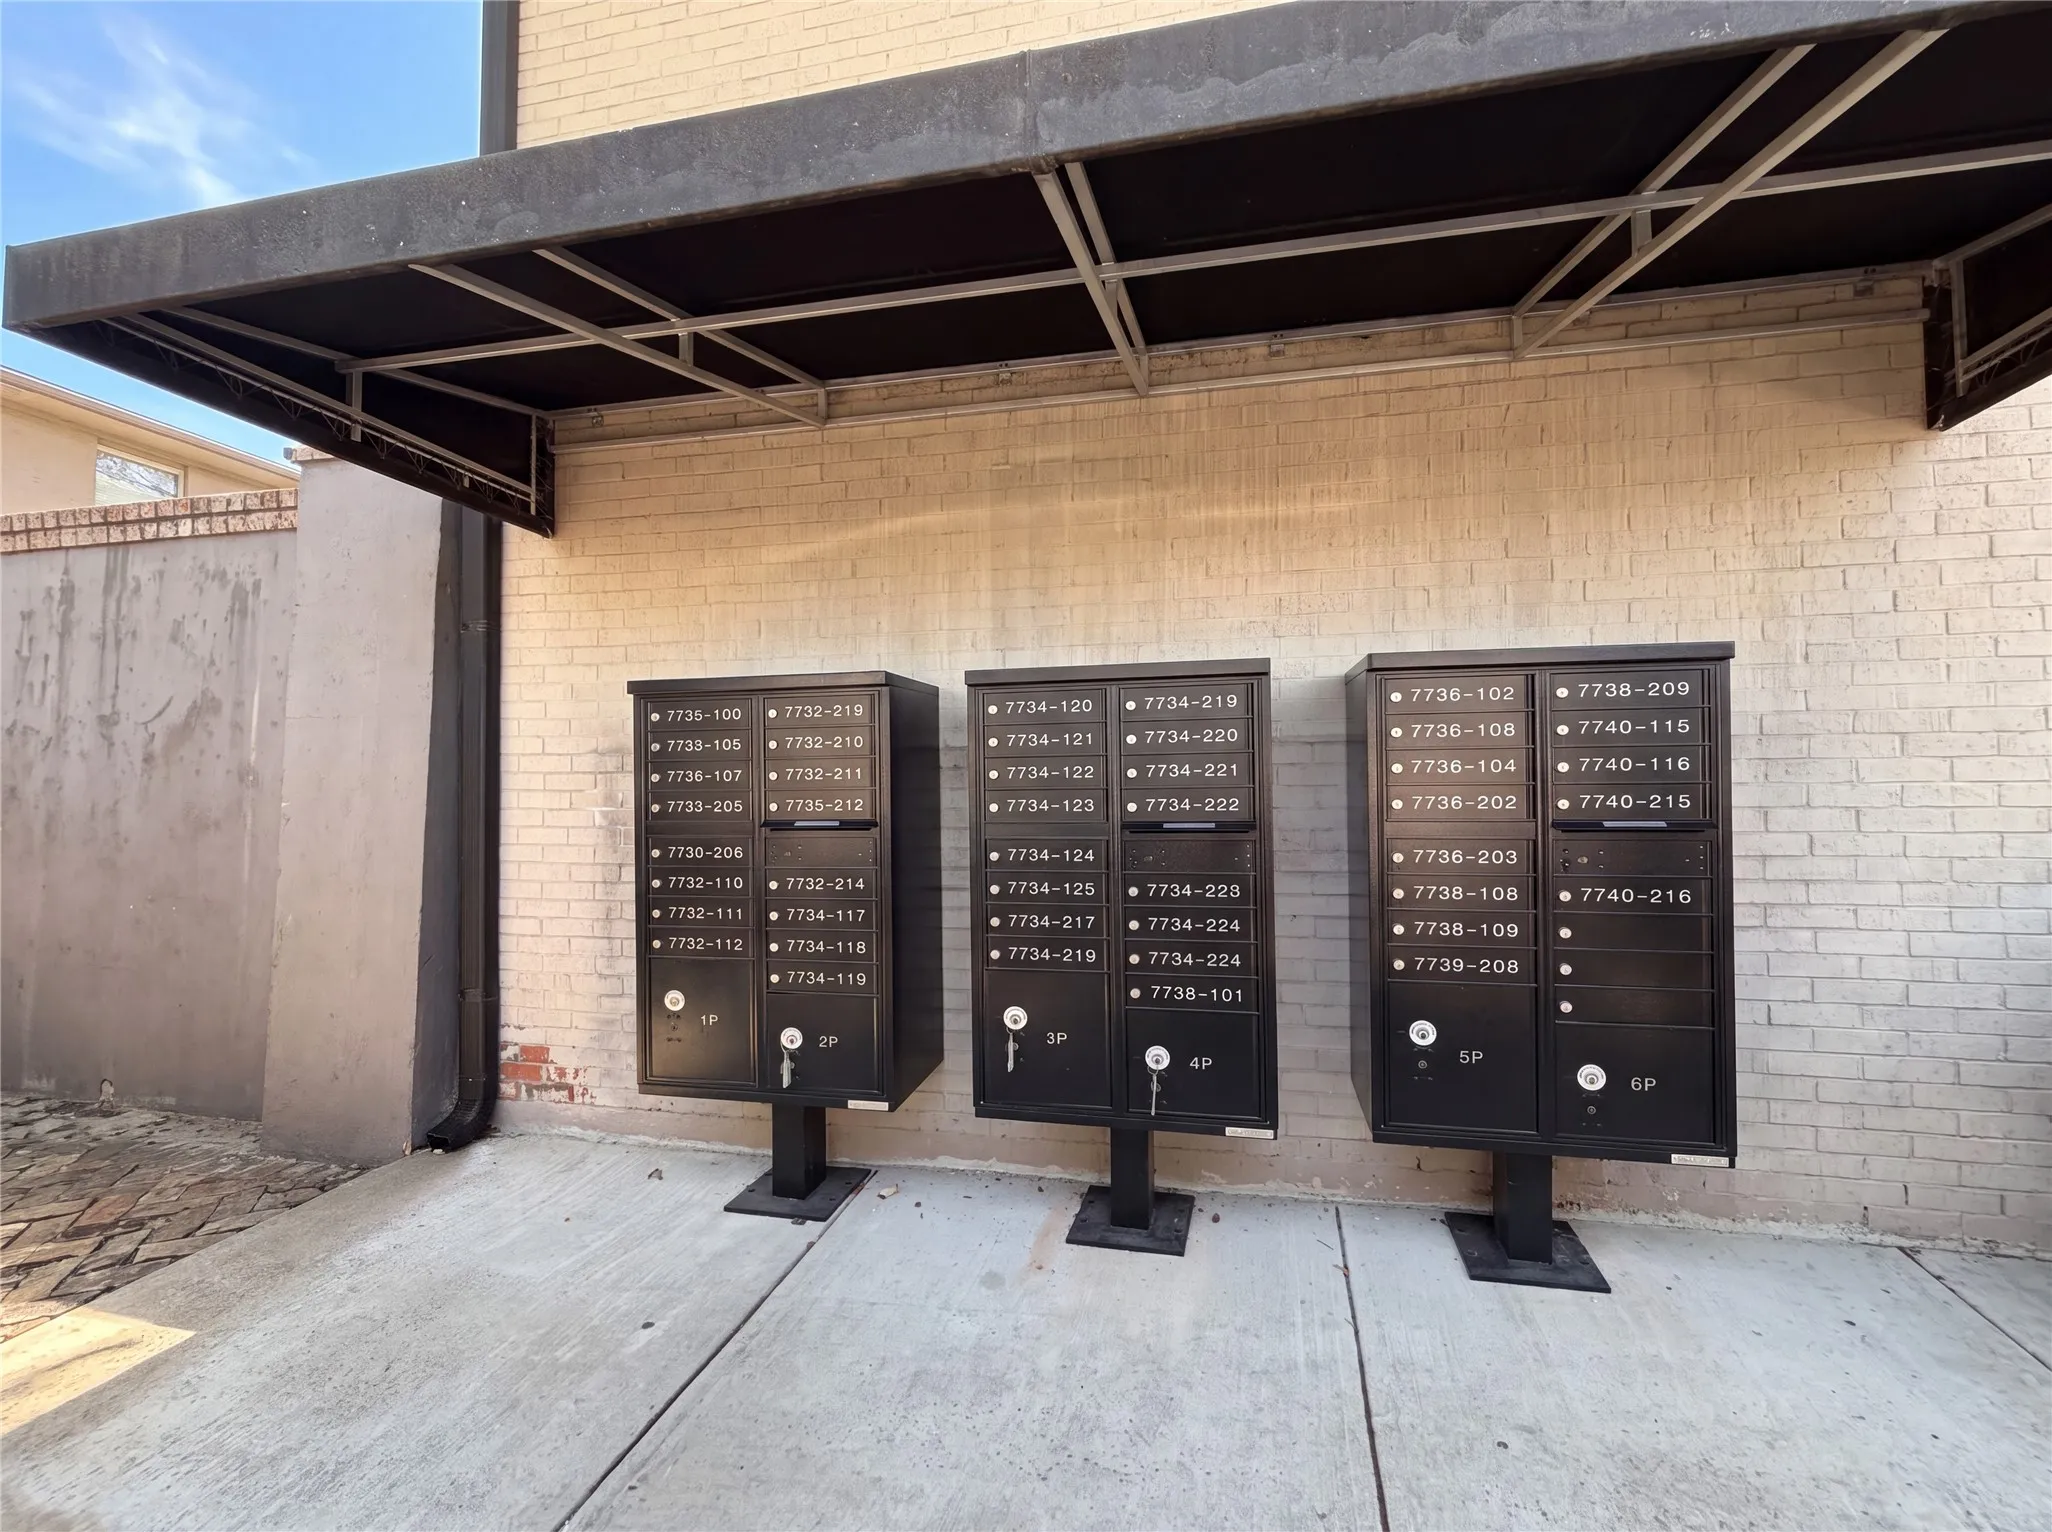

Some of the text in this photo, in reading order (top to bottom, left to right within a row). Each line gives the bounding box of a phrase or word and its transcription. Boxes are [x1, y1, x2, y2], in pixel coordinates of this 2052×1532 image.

[1410, 686, 1514, 702] 7736-102
[1578, 681, 1690, 698] 7738-209
[1005, 699, 1093, 714] 7734-120
[1144, 694, 1238, 710] 7734-219
[667, 707, 742, 722] 7735-100
[784, 703, 863, 718] 7732-219
[1411, 722, 1516, 738] 7736-108
[1578, 719, 1690, 735] 7740-115
[784, 735, 864, 749] 7732-210
[1006, 732, 1092, 747] 7734-121
[1144, 728, 1238, 744] 7734-220
[1145, 763, 1237, 778] 7734-221
[1410, 758, 1517, 774] 7736-104
[1579, 756, 1690, 772] 7740-116
[667, 769, 742, 783] 7736-107
[785, 767, 861, 781] 7732-211
[1006, 765, 1094, 780] 7734-122
[667, 800, 743, 813] 7733-205
[785, 798, 864, 812] 7735-212
[1006, 798, 1095, 812] 7734-123
[1145, 797, 1239, 812] 7734-222
[1411, 795, 1517, 810] 7736-202
[1579, 794, 1691, 809] 7740-215
[668, 846, 743, 859] 7730-206
[1007, 848, 1095, 862] 7734-124
[1413, 849, 1518, 865] 7736-203
[668, 876, 743, 889] 7732-110
[786, 877, 865, 890] 7732-214
[1007, 881, 1095, 896] 7734-125
[1413, 885, 1518, 901] 7738-108
[1580, 887, 1692, 904] 7740-216
[668, 906, 742, 920] 7732-111
[786, 908, 865, 922] 7734-117
[1008, 914, 1095, 929] 7734-217
[1148, 917, 1241, 932] 7734-224
[1414, 921, 1519, 938] 7738-109
[668, 937, 743, 951] 7732-112
[786, 939, 866, 954] 7734-118
[1008, 946, 1096, 963] 7734-219
[1148, 951, 1241, 967] 7734-224
[1414, 957, 1519, 974] 7739-208
[787, 971, 866, 986] 7734-119
[1151, 985, 1242, 1003] 7738-101
[700, 1014, 719, 1026] 1P
[818, 1035, 838, 1048] 2P
[1046, 1032, 1068, 1045] 3P
[1189, 1056, 1213, 1070] 4P
[1459, 1050, 1484, 1064] 5P
[1630, 1076, 1657, 1092] 6P
